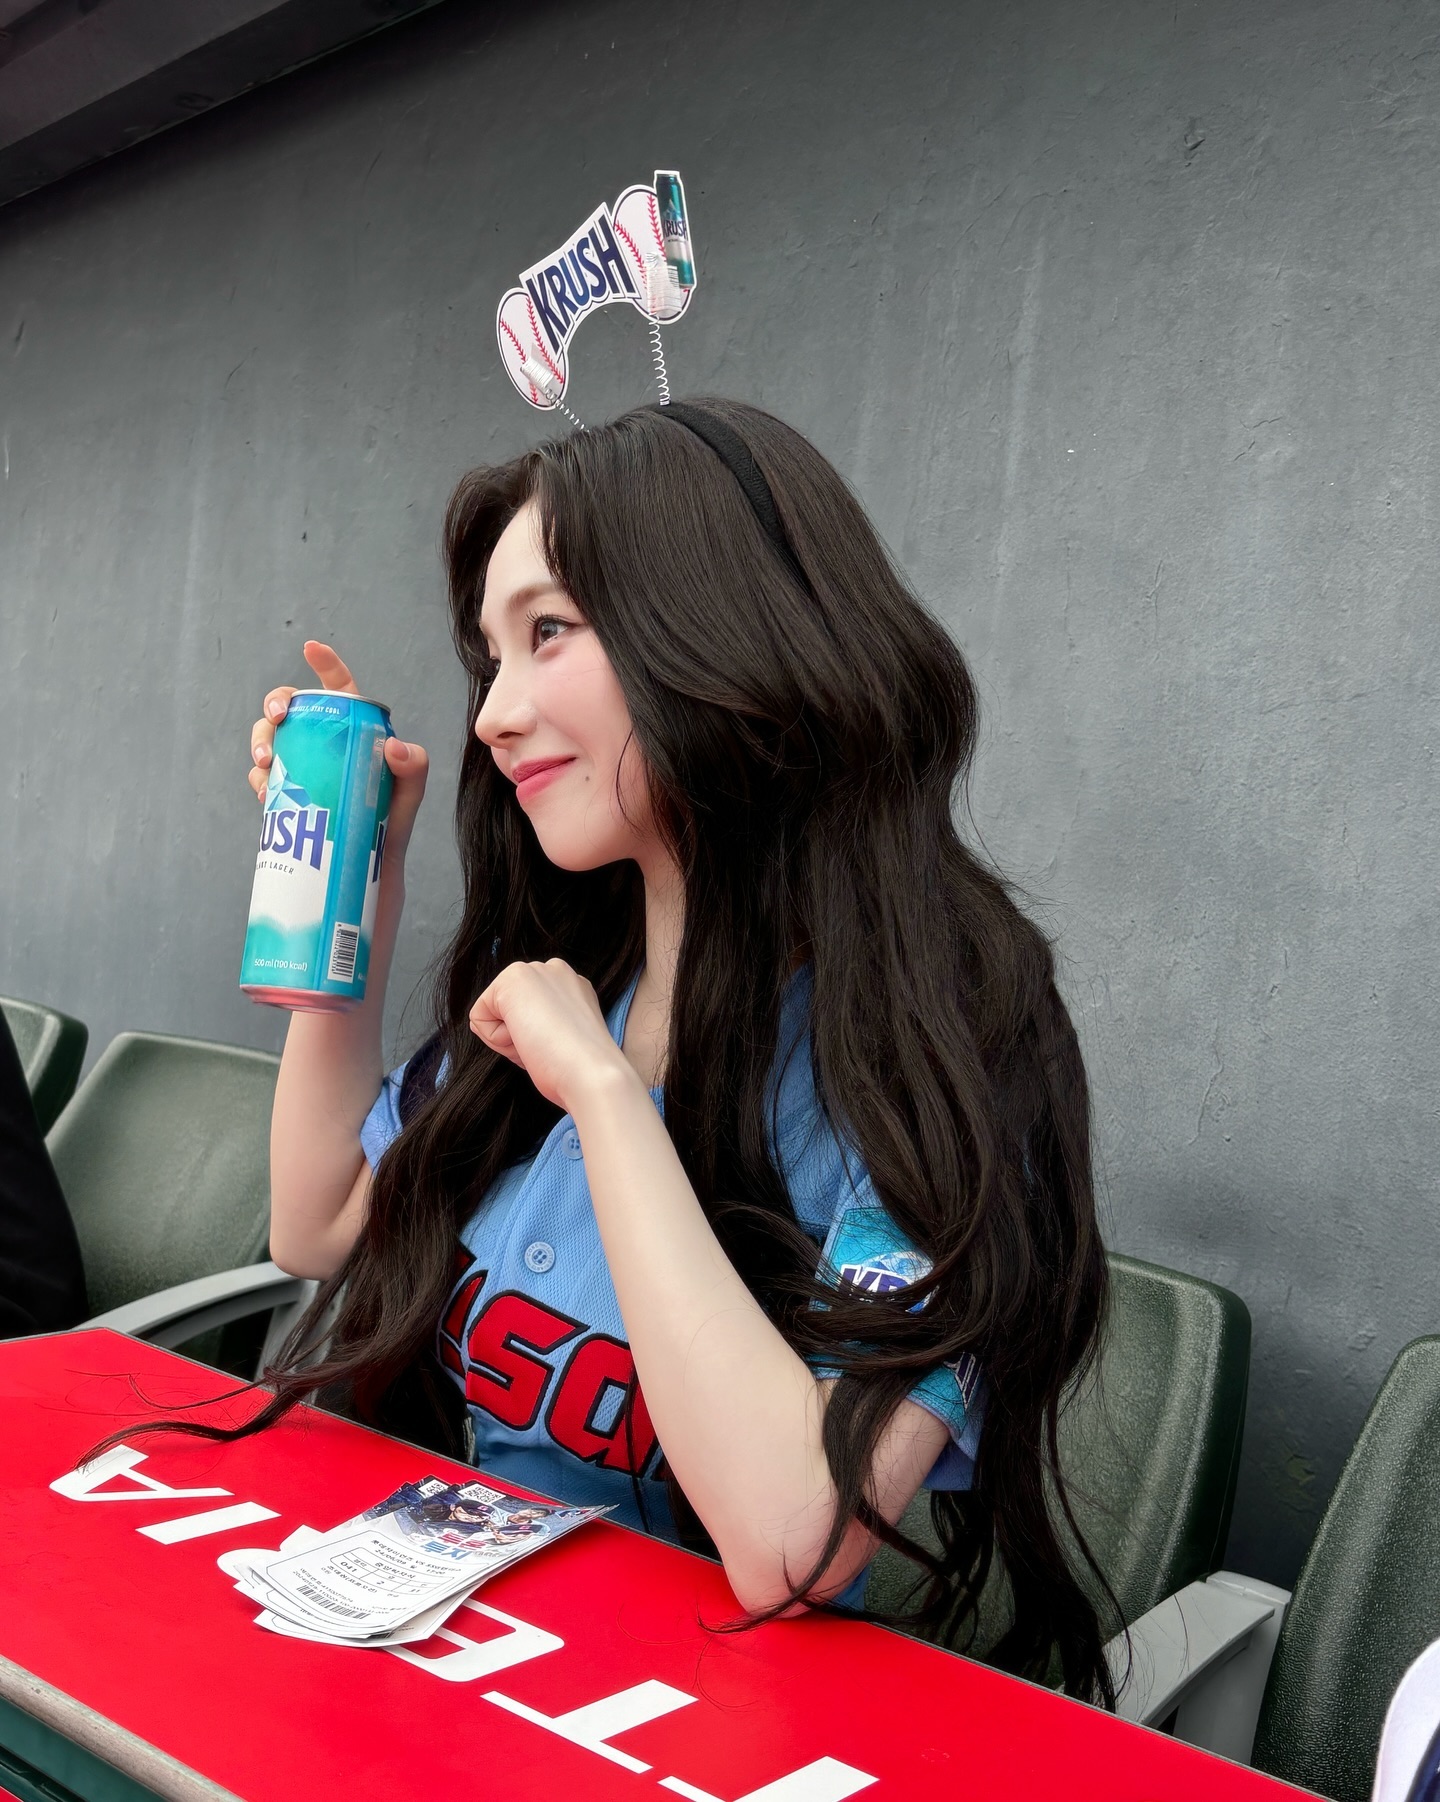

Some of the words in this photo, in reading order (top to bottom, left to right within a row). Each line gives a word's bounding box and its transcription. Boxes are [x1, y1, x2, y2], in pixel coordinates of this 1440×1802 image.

[526, 214, 636, 354] KRUSH
[310, 705, 324, 713] STAY
[325, 706, 340, 715] COOL
[260, 810, 328, 871] USH
[269, 861, 294, 875] LAGER
[274, 958, 289, 969] (190
[289, 960, 308, 972] kcal)
[419, 1540, 473, 1560] 투지
